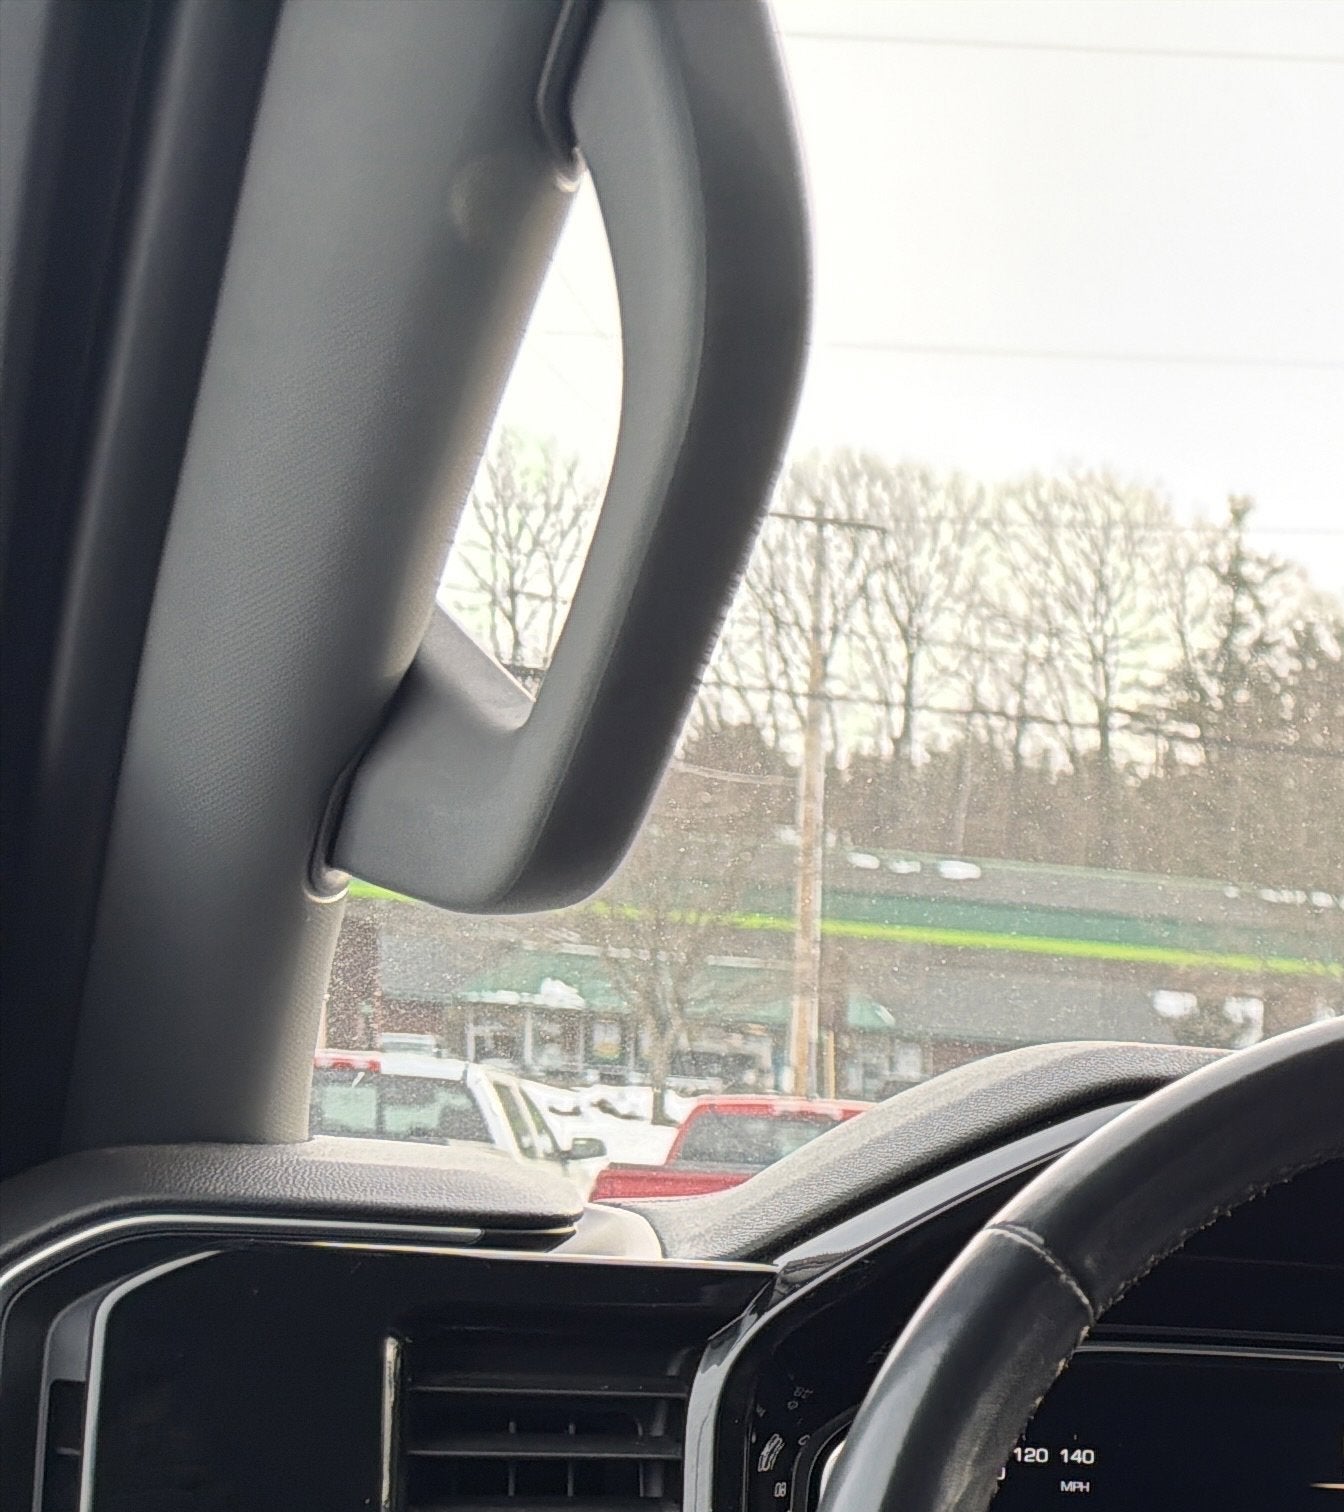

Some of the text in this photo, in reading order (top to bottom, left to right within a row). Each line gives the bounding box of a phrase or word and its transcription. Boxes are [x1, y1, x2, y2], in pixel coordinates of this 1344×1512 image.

[1013, 1447, 1095, 1465] 120 140
[1060, 1481, 1090, 1493] MPH
